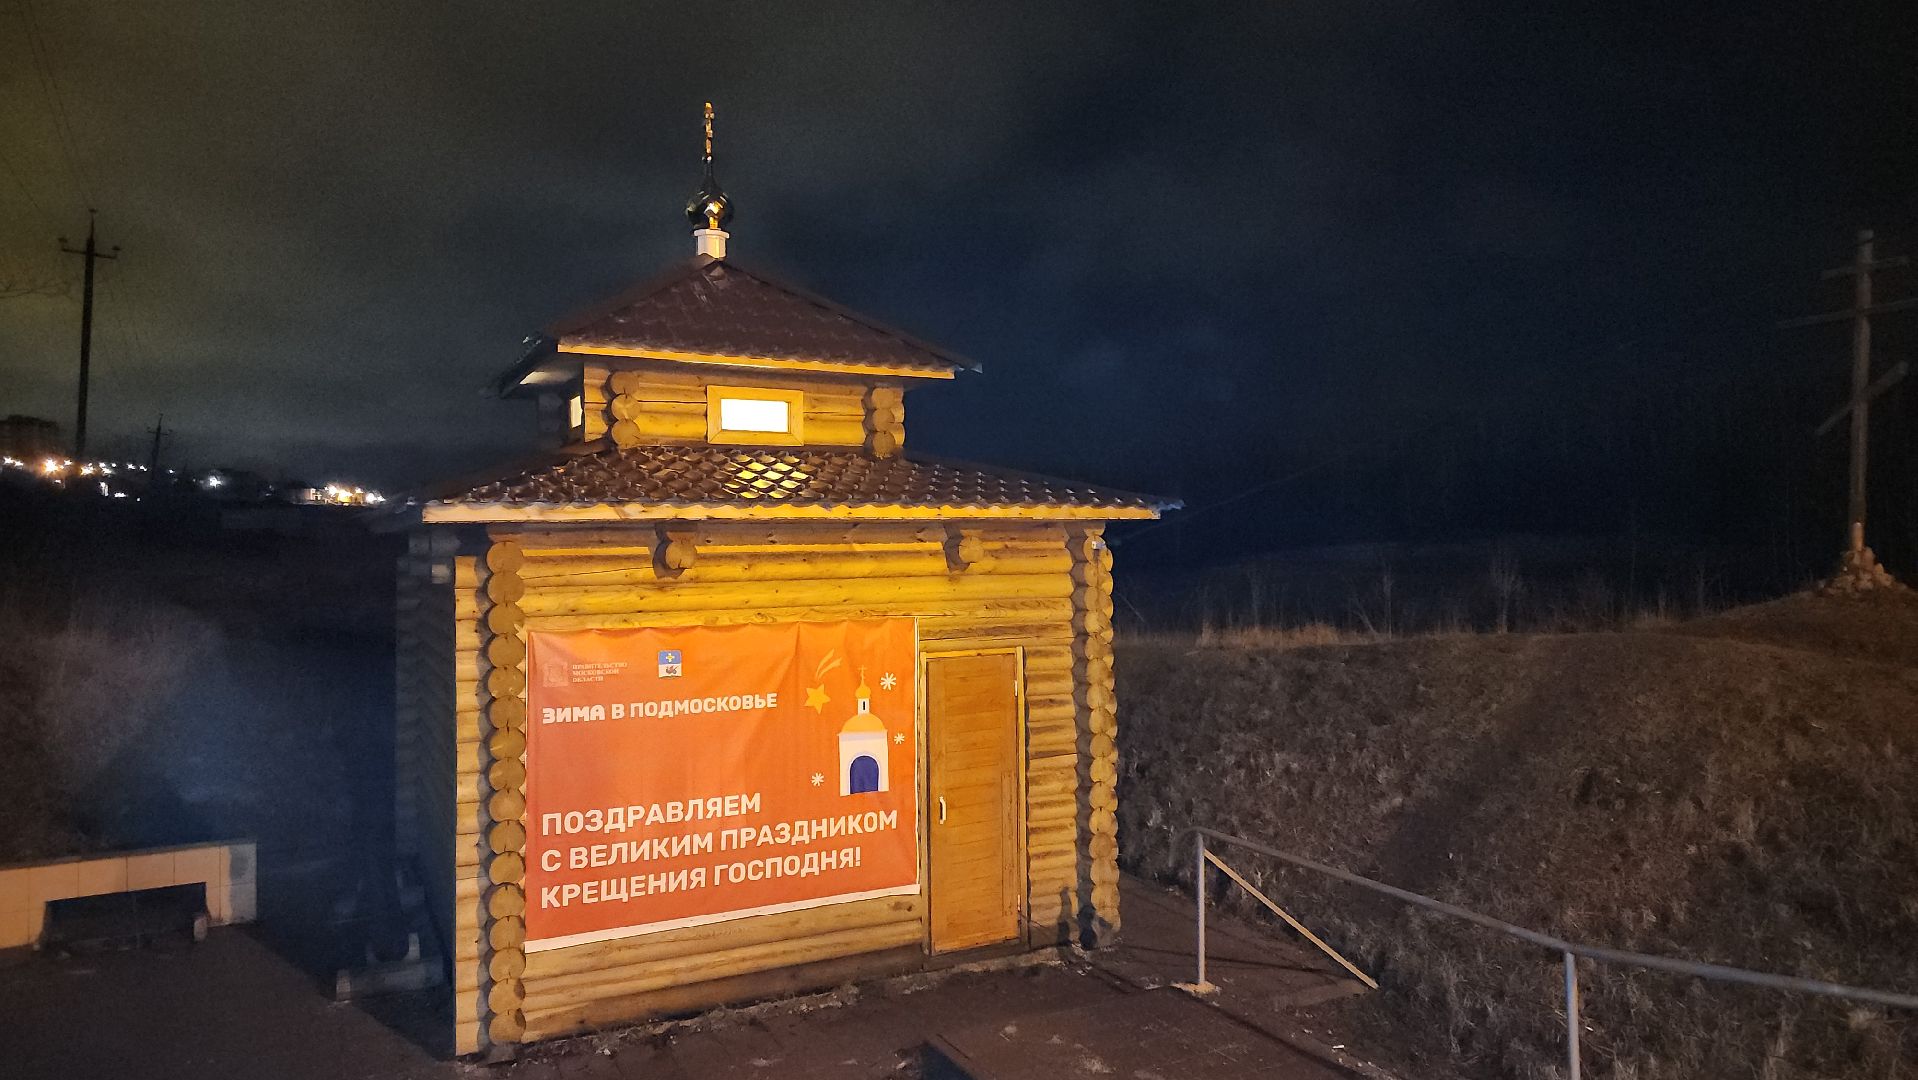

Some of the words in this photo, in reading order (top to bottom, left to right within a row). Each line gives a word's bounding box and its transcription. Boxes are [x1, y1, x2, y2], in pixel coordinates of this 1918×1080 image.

[542, 704, 605, 724] ЗИМА
[611, 703, 625, 720] В
[629, 692, 778, 719] ПОДМОСКОВЬЕ
[541, 792, 761, 836] ПОЗДРАВЛЯЕМ
[541, 849, 562, 872] С
[569, 831, 714, 870] ВЕЛИКИМ
[720, 809, 898, 850] ПРАЗДНИКОМ
[541, 866, 706, 909] КРЕЩЕНИЯ
[713, 846, 861, 886] ГОСПОДНЯ!
